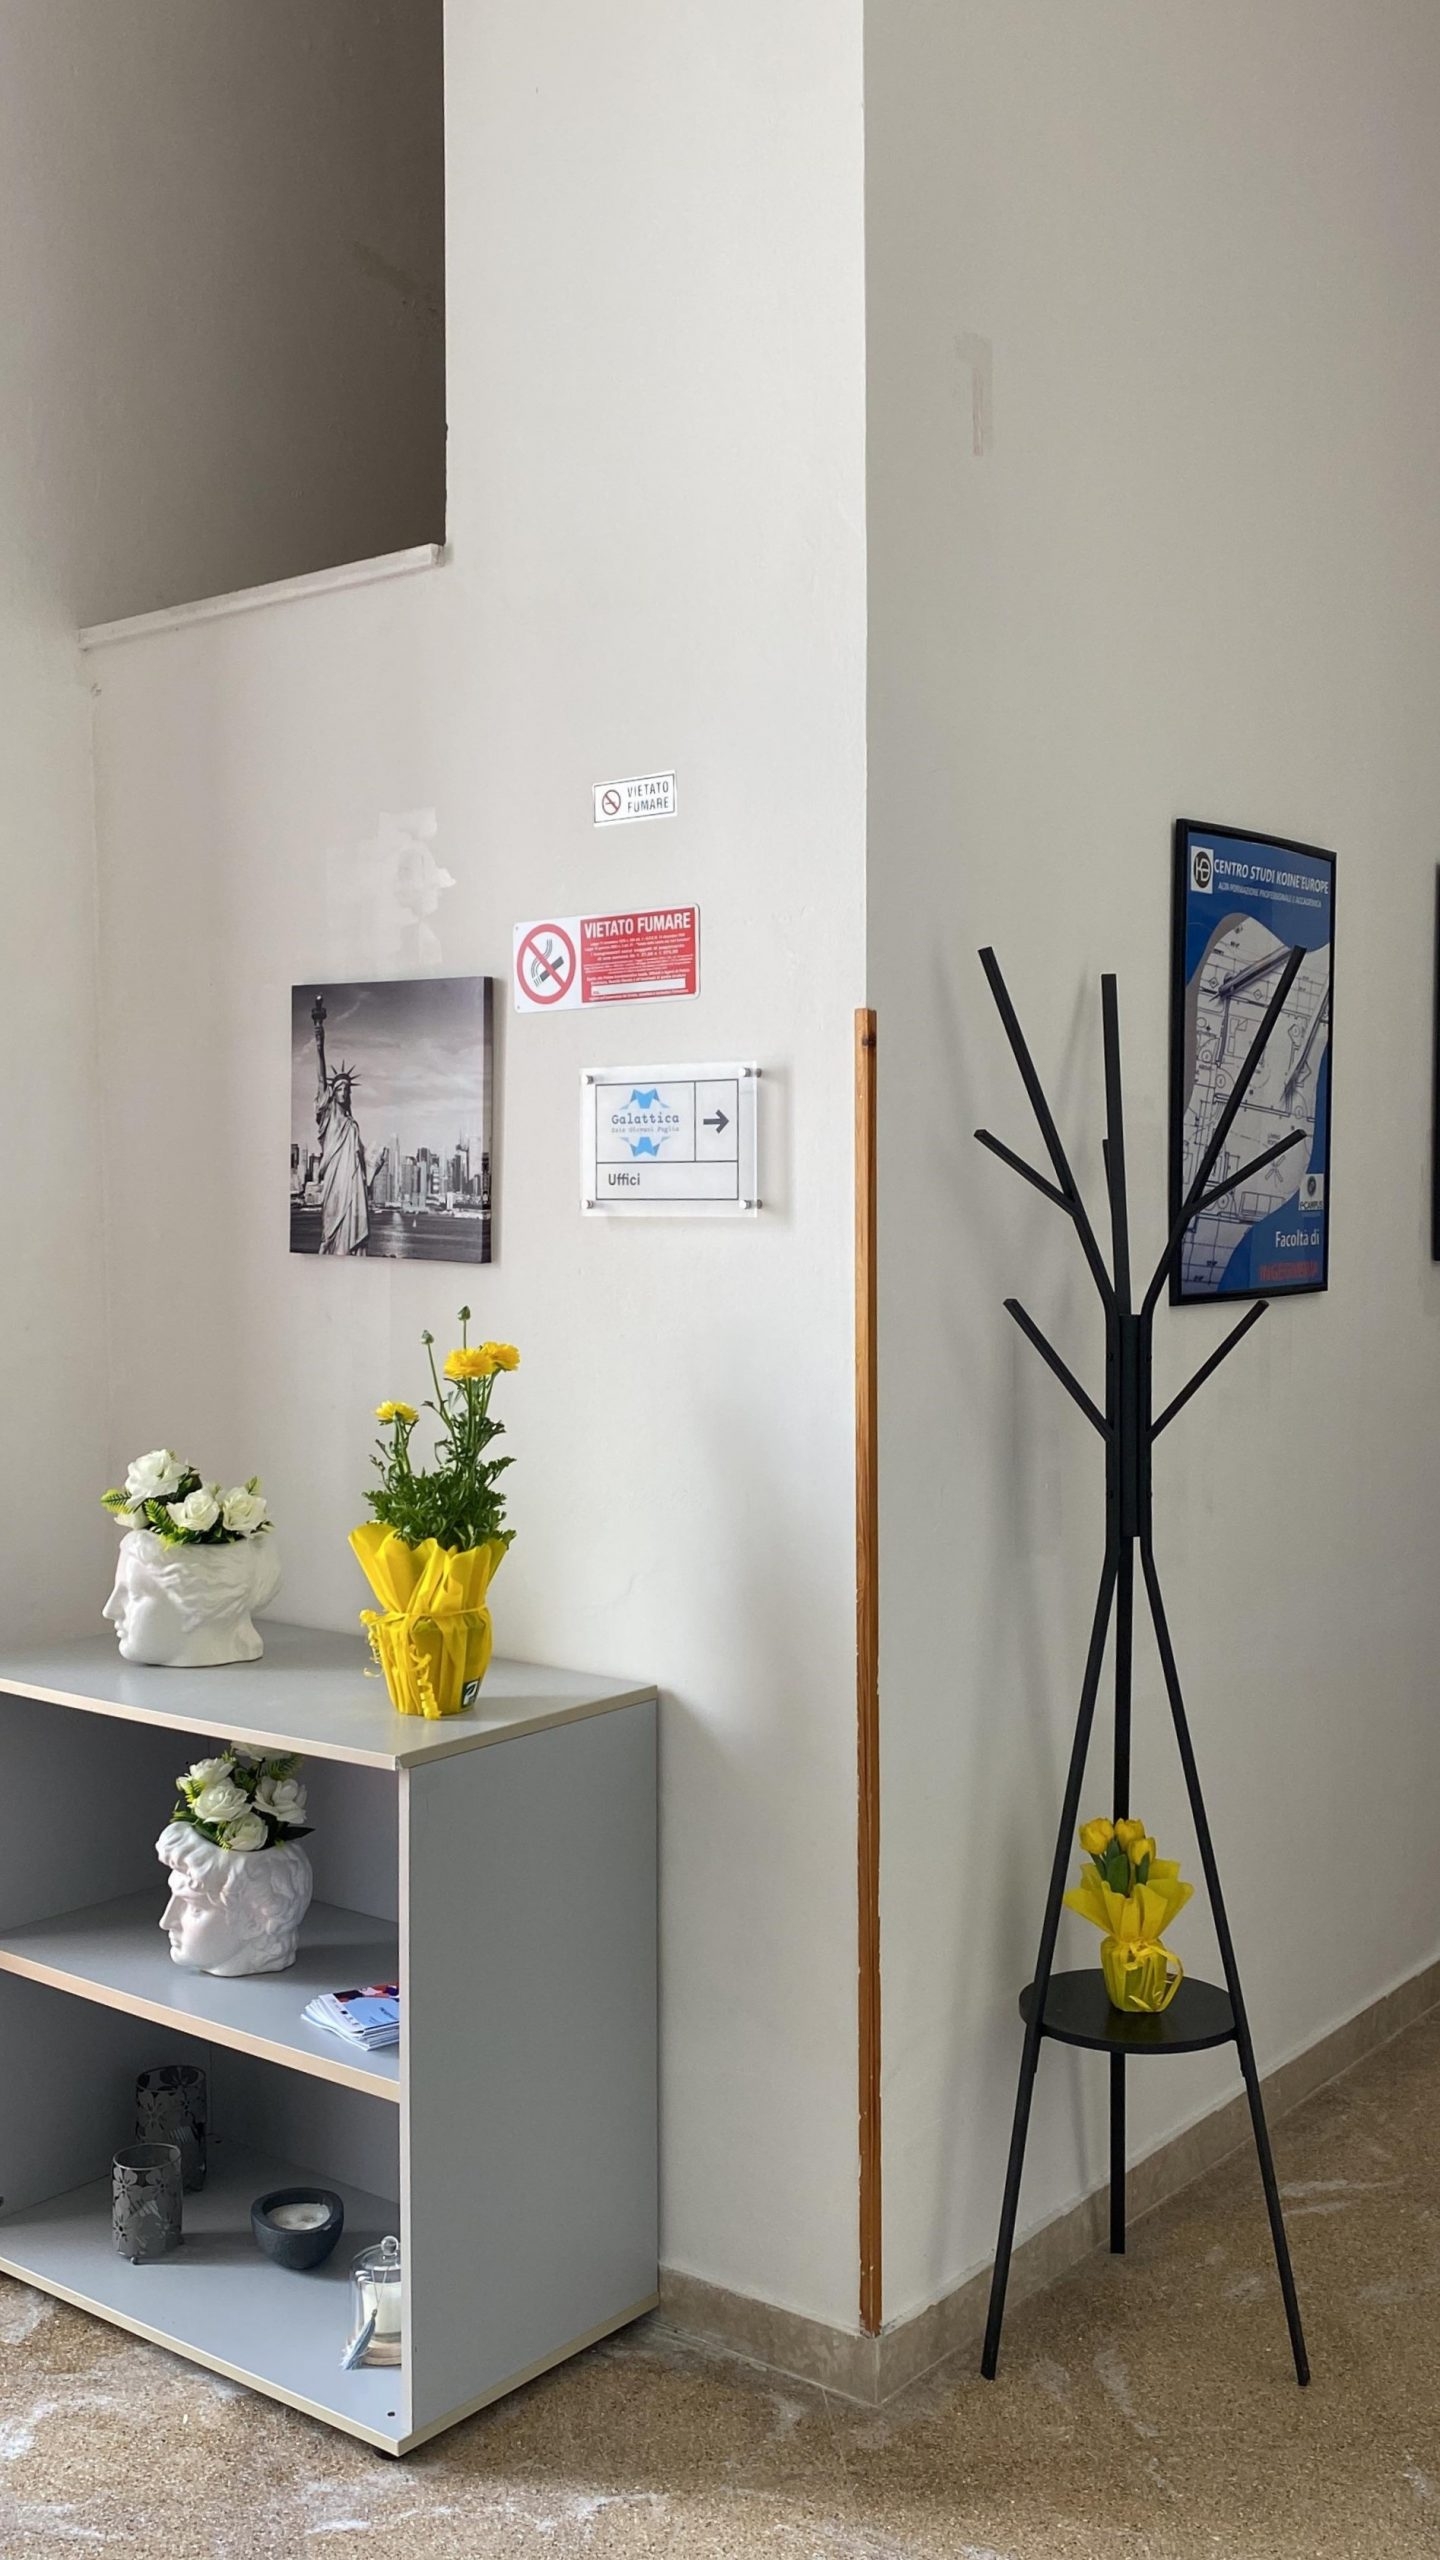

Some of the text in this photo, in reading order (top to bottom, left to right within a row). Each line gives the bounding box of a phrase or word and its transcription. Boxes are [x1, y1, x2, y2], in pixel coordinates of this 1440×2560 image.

[627, 781, 669, 798] VIETATO
[627, 797, 669, 813] FUMARE
[1214, 859, 1249, 879] CENTRO
[1250, 865, 1275, 883] STUDI
[584, 912, 691, 939] VIETATO FUMARE
[611, 1112, 680, 1125] Galattica
[608, 1172, 641, 1186] Uffici
[1311, 1228, 1320, 1246] di
